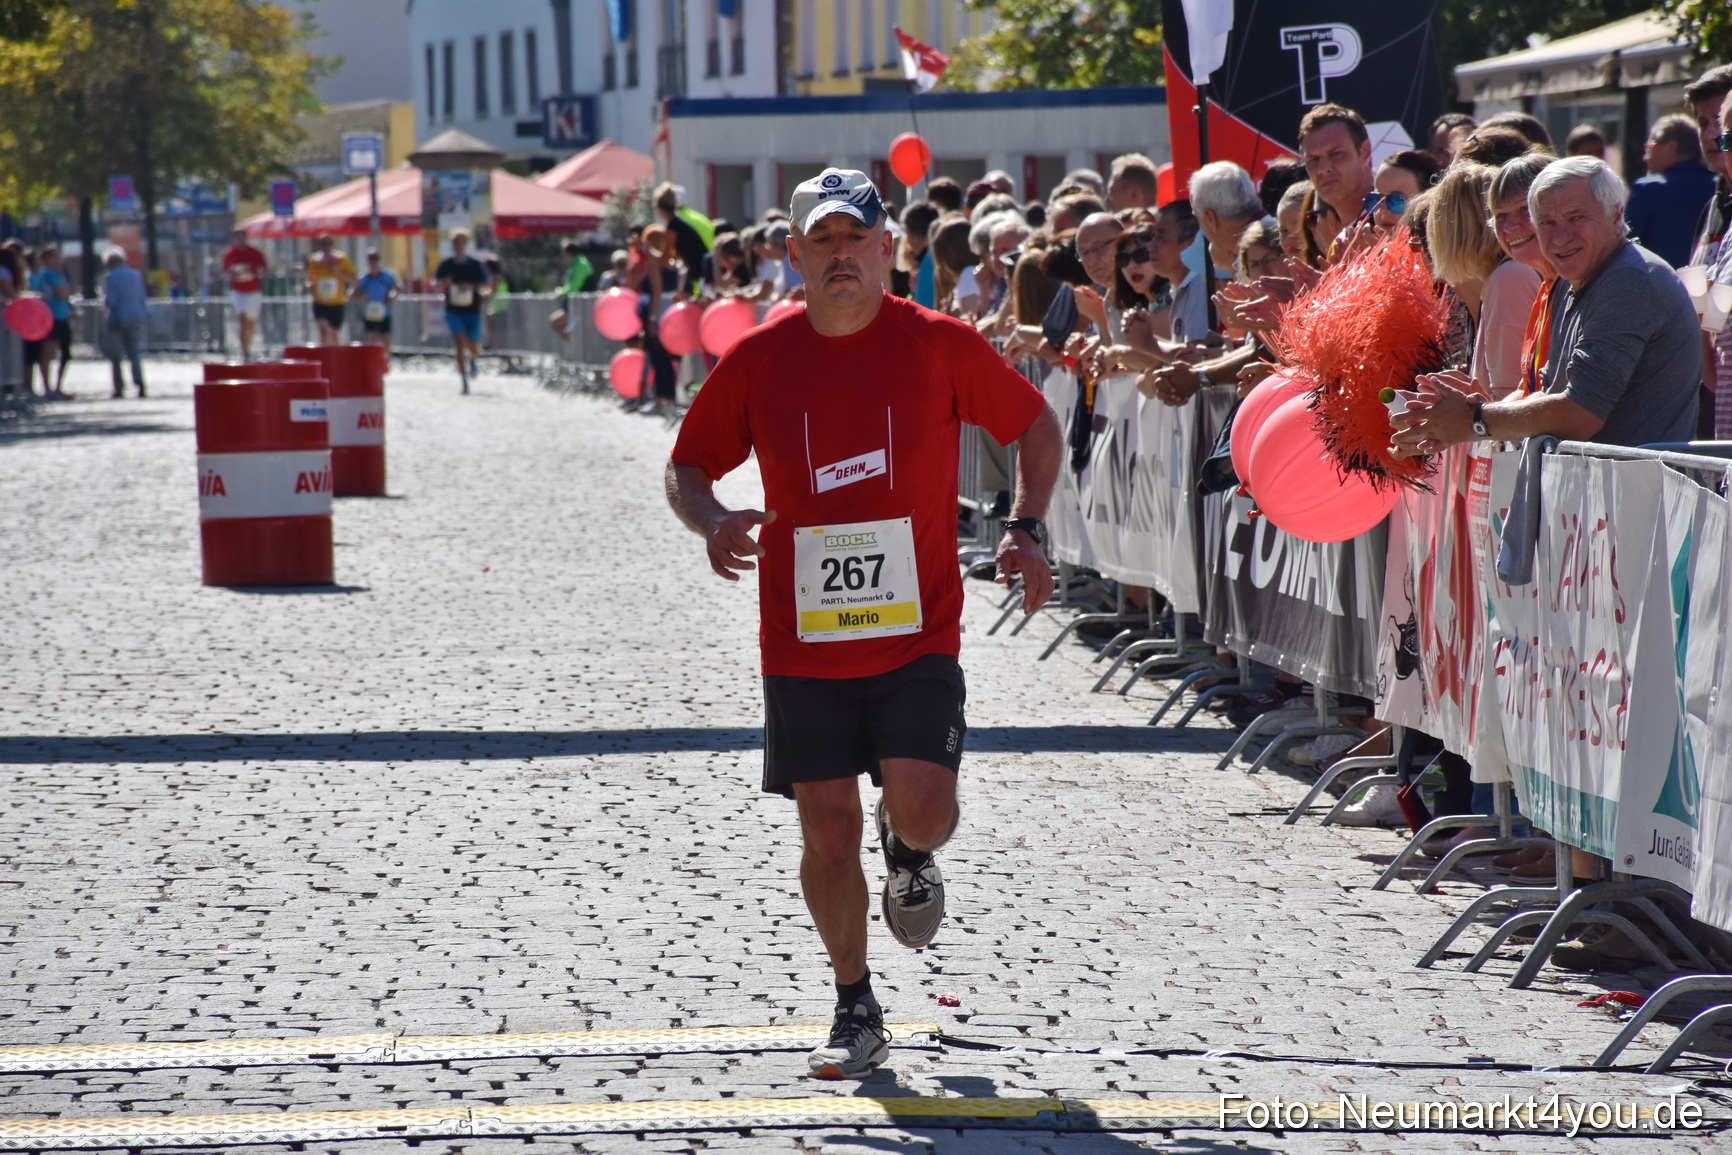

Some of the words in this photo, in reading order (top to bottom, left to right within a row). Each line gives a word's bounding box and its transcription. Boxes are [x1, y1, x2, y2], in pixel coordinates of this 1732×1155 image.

[1286, 33, 1310, 42] Team
[818, 189, 850, 199] BMW
[835, 461, 867, 481] DEHN
[825, 532, 877, 547] BOCK
[821, 554, 885, 592] 267
[820, 598, 846, 606] PARTL
[846, 594, 884, 605] Neumarkt
[837, 610, 880, 628] Mario
[946, 726, 956, 752] GORE
[1648, 828, 1674, 860] Jura
